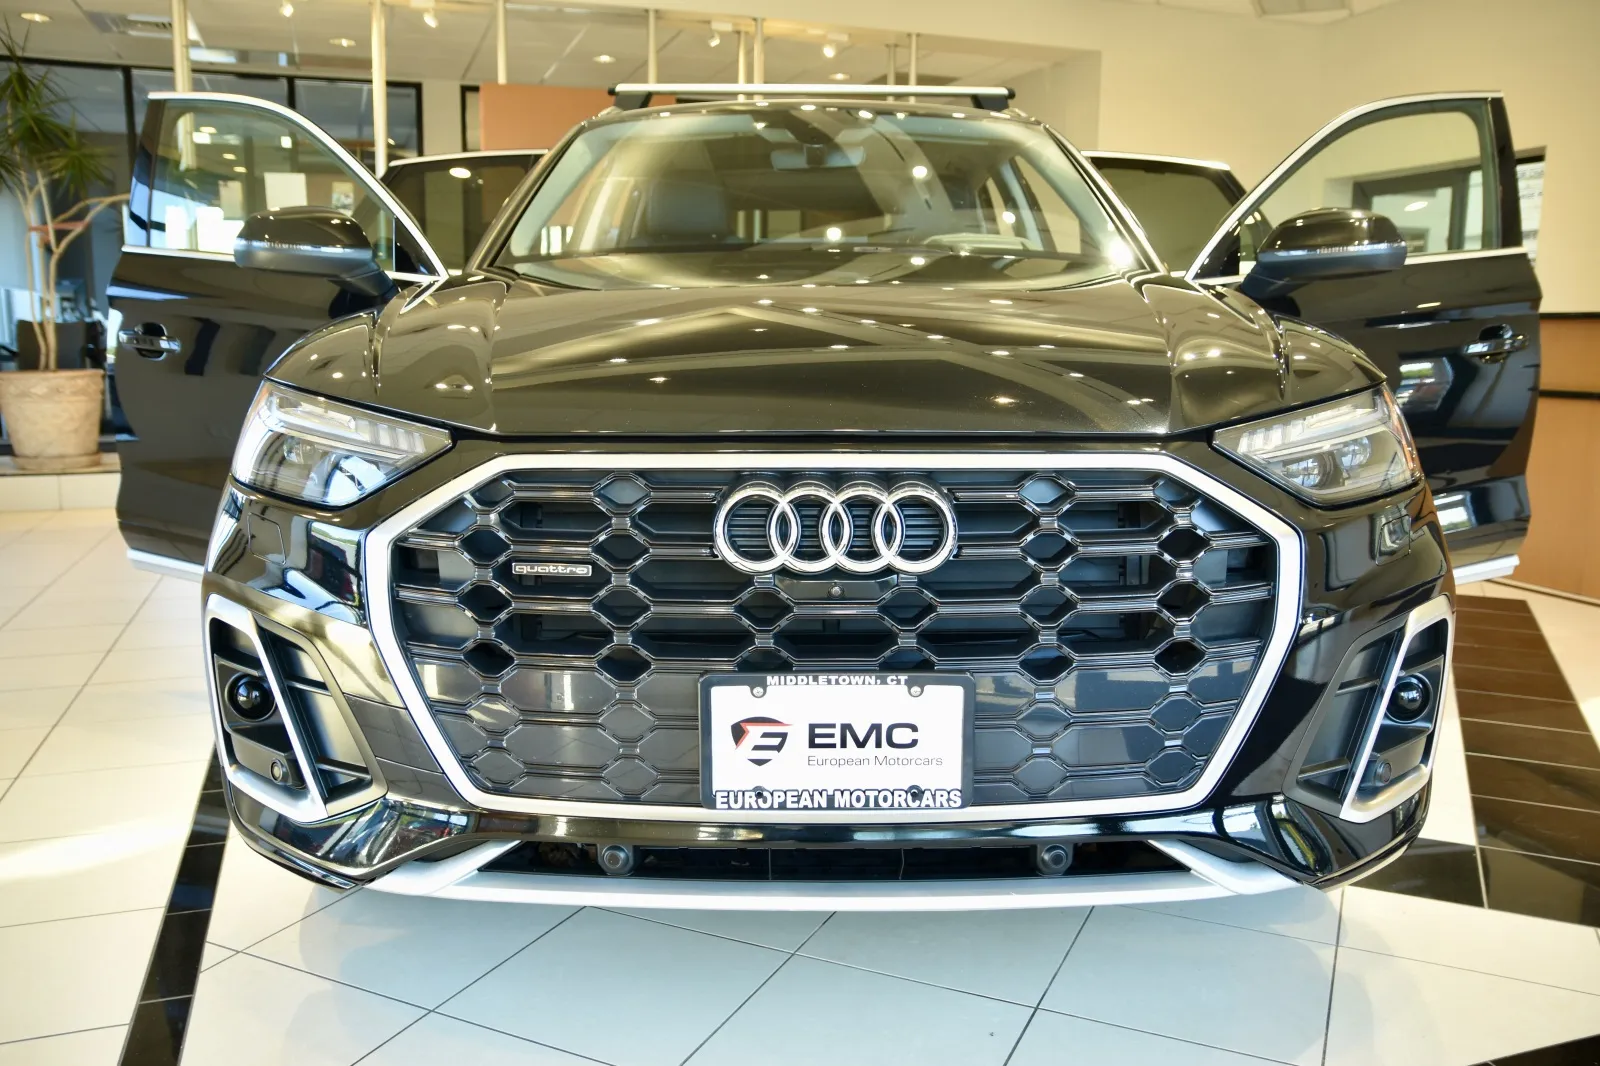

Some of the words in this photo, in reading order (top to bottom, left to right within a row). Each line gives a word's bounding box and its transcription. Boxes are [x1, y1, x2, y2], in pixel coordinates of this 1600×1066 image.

[515, 565, 588, 574] quattro
[767, 675, 882, 686] MIDDLETOWN,
[886, 675, 908, 686] CT
[808, 723, 919, 749] EMC
[807, 755, 870, 768] European
[874, 755, 943, 766] Motorcars
[715, 791, 828, 809] EUROPEAN
[836, 790, 962, 808] MOTORCARS
